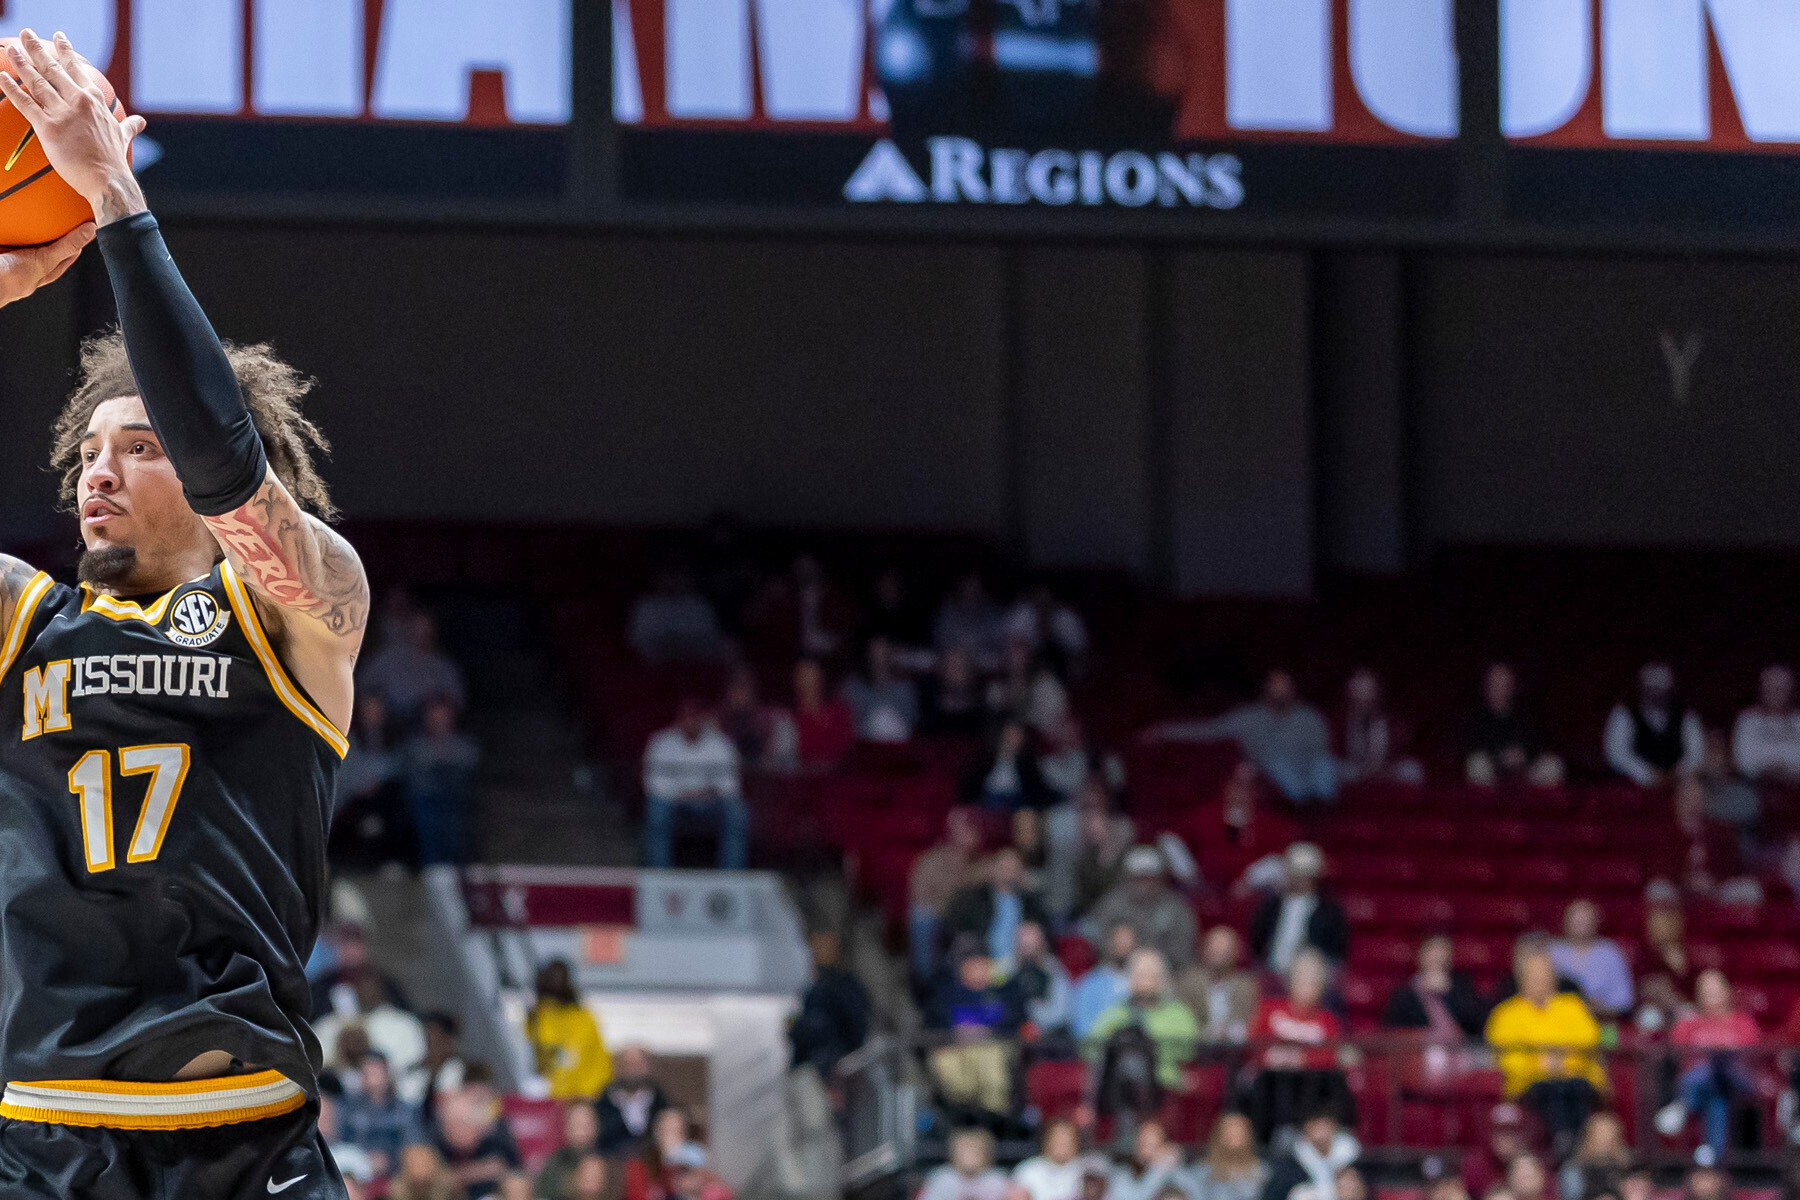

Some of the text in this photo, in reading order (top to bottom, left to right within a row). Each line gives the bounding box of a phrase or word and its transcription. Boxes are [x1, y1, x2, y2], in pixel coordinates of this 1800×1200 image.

[174, 594, 215, 634] SEC
[175, 622, 225, 646] GRADUATE
[22, 653, 232, 741] MISSOURI
[67, 743, 191, 874] 17
